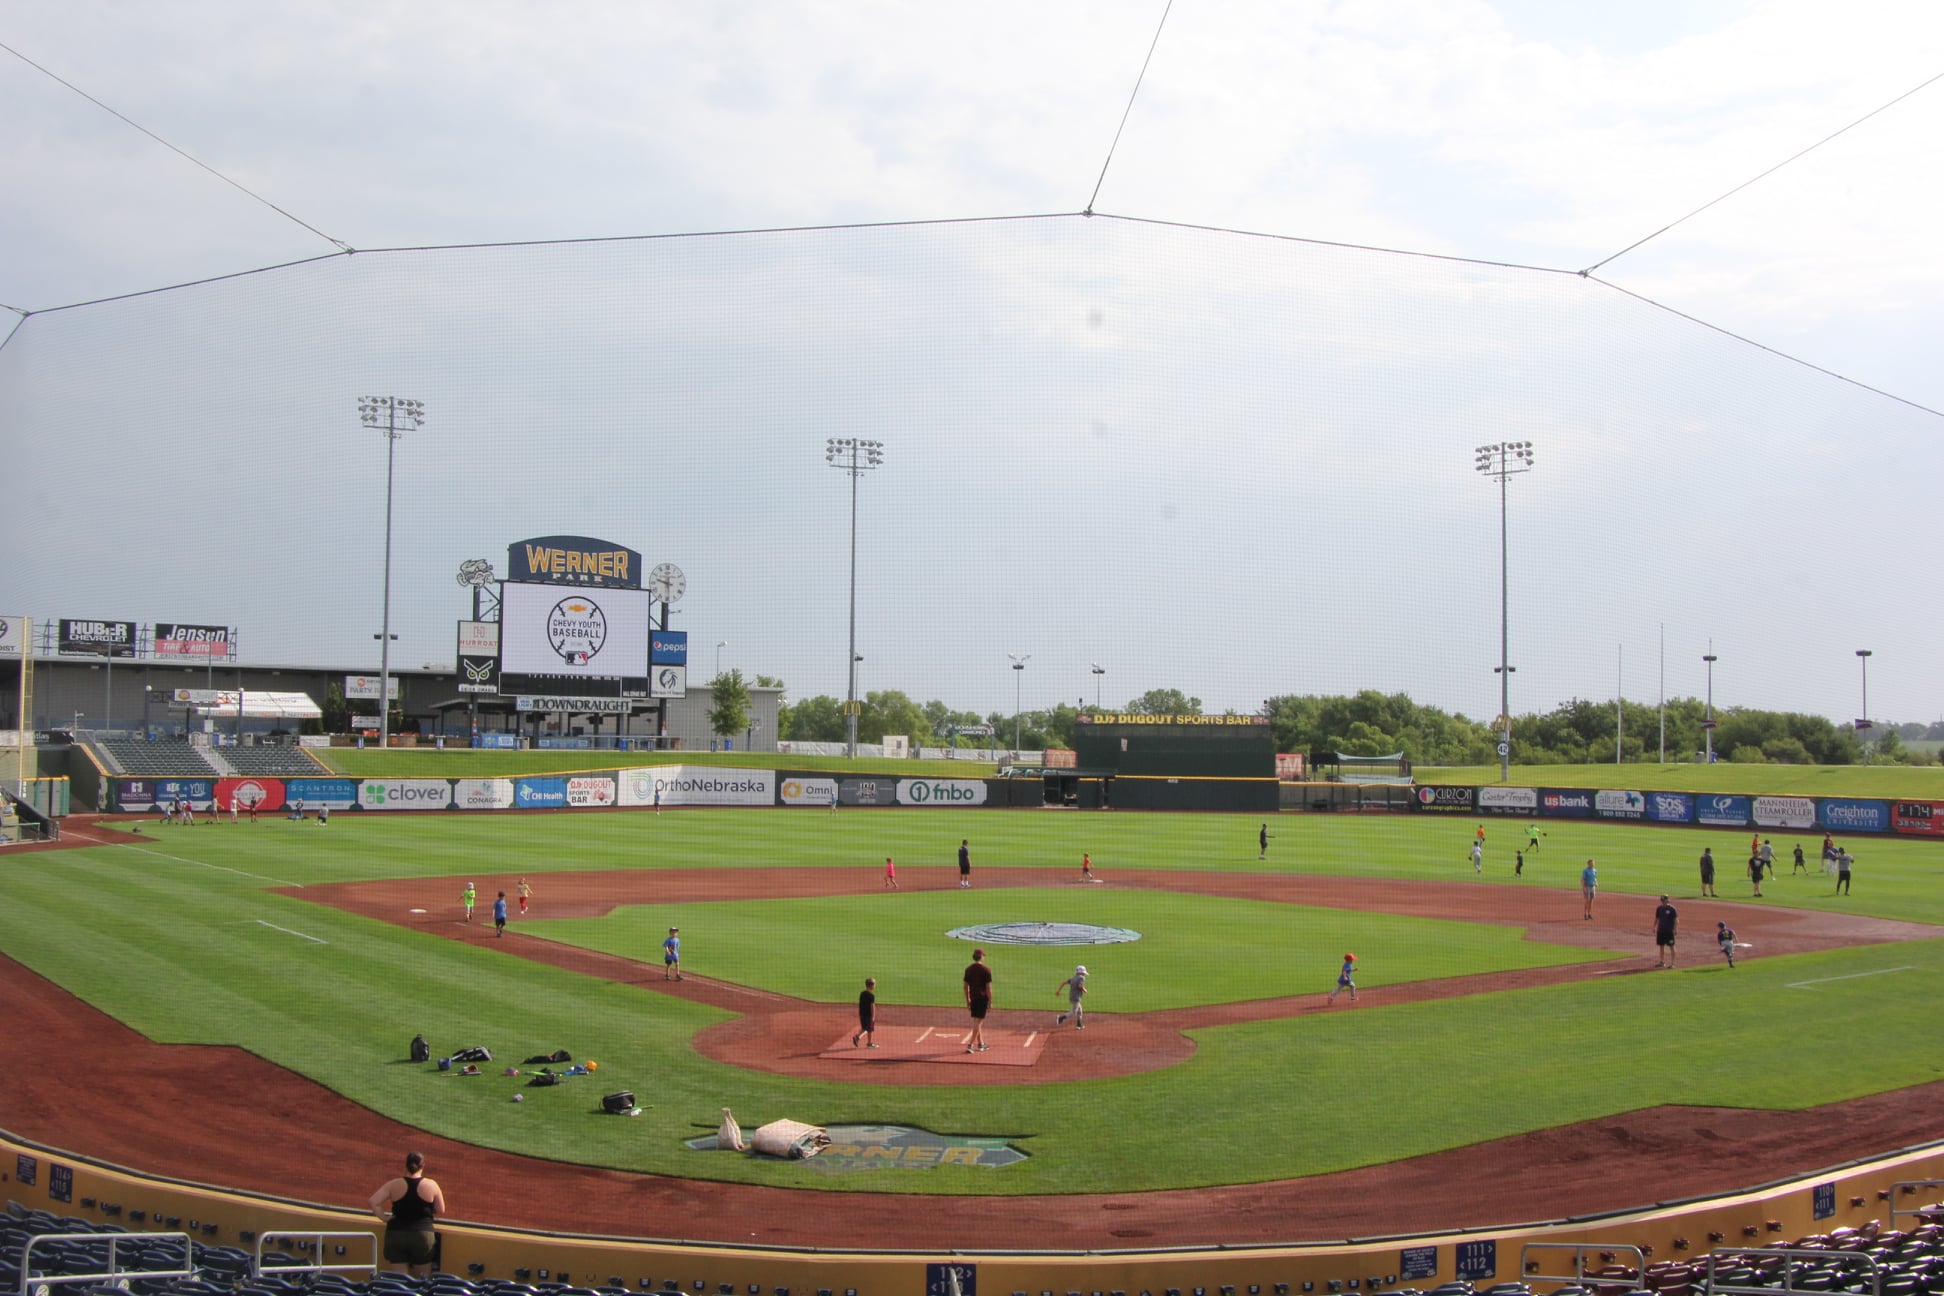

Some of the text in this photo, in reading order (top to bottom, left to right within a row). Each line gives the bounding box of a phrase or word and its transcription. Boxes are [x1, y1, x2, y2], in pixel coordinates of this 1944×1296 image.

[526, 544, 628, 580] WERNER
[552, 573, 602, 581] PARK
[553, 619, 601, 629] CHEVY YOUTH
[69, 634, 127, 642] CHEVROLET
[553, 628, 601, 639] BASEBALL
[663, 643, 687, 653] pepsi
[537, 699, 630, 712] DOWNDRAUGHT
[1118, 714, 1173, 724] DUGOUT
[1176, 714, 1224, 725] SPORTS
[1226, 715, 1251, 725] BAR
[583, 780, 611, 789] DUGOUT
[655, 779, 765, 792] OrthoNebraska
[806, 785, 833, 795] Omni
[388, 784, 445, 800] clover
[531, 792, 542, 800] CHI
[933, 783, 974, 801] fnbo
[1436, 788, 1472, 800] CURZON
[1559, 795, 1589, 807] bank
[1759, 799, 1808, 807] MANNHEIM
[1755, 807, 1814, 817] STEAMROLLER
[1826, 804, 1879, 819] Creighton
[827, 1143, 983, 1165] RNER
[1467, 1243, 1485, 1257] 111
[1467, 1257, 1486, 1271] 112
